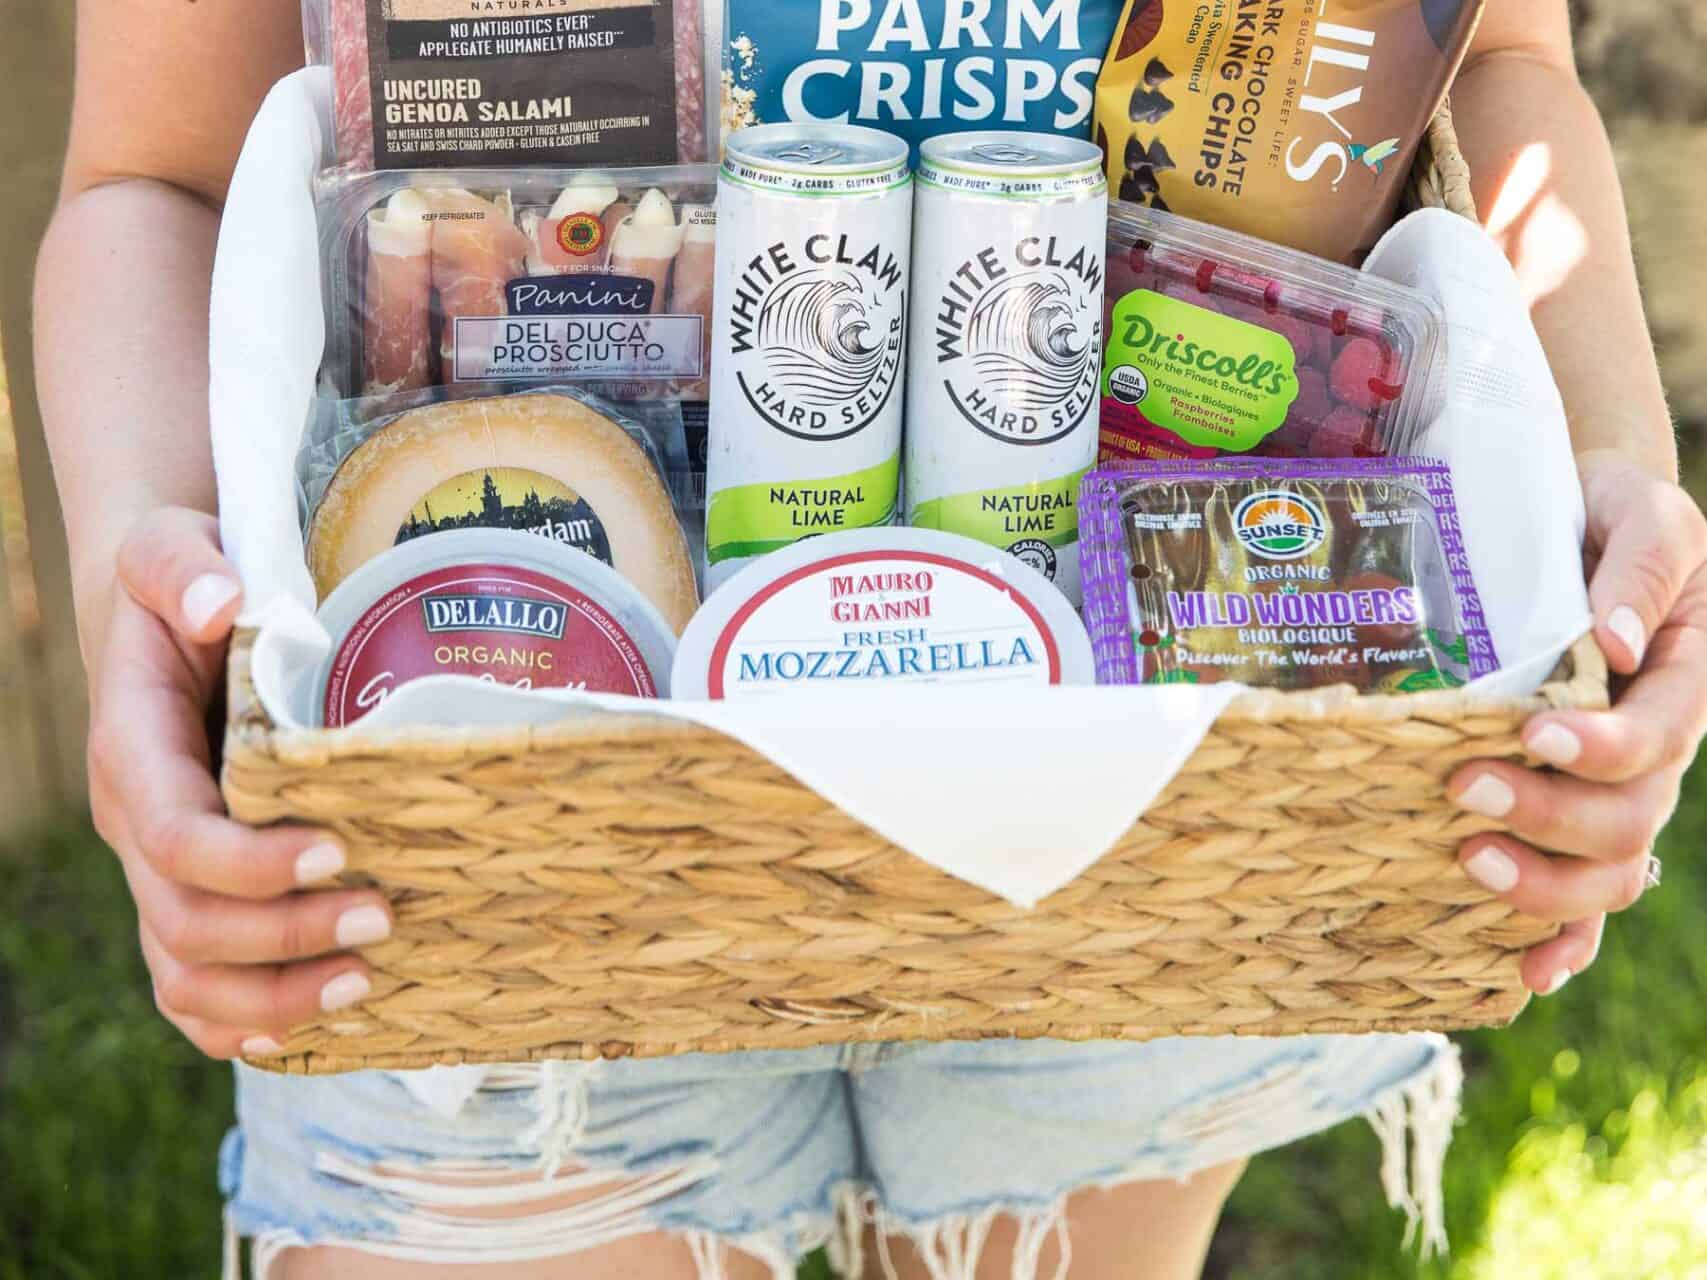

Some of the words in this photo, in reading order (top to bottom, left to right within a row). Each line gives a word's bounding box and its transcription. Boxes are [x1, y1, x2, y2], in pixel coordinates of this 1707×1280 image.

[450, 23, 469, 39] NO
[472, 18, 553, 37] ANTIBIOTICS
[1186, 5, 1210, 45] Cacao
[419, 40, 493, 57] APPLEGATE
[496, 35, 565, 54] HUMANELY
[1187, 21, 1223, 94] Sweetened
[383, 78, 481, 100] UNCURED
[782, 55, 1102, 130] CRISPS
[1279, 77, 1297, 126] SWEET
[385, 102, 469, 124] GENOA
[478, 96, 572, 122] SALAMI
[1222, 45, 1275, 197] CHOCOLATE
[386, 129, 397, 140] NO
[398, 128, 433, 139] NITRATES
[434, 128, 446, 139] OR
[446, 127, 479, 139] NITRITES
[481, 126, 505, 138] ADDED
[506, 125, 533, 137] EXCEPT
[535, 124, 560, 136] THOSE
[560, 120, 599, 134] NATURALLY
[599, 116, 641, 130] OCCURRING
[642, 114, 650, 128] IN
[1193, 92, 1236, 189] CHIPS
[386, 141, 401, 152] SEA
[401, 141, 419, 152] SALT
[420, 140, 435, 152] AND
[435, 140, 458, 151] SWISS
[459, 139, 483, 151] CHARD
[484, 138, 515, 150] POWDER
[520, 136, 548, 148] GLUTEN
[549, 136, 555, 147] &
[555, 134, 581, 147] CASEIN
[582, 131, 601, 144] FREE
[739, 167, 757, 181] MADE
[791, 179, 802, 189] 2g
[805, 179, 834, 189] CARBS
[846, 177, 875, 188] GLUTEN
[876, 175, 892, 185] FREE
[943, 175, 962, 185] MADE
[1000, 183, 1011, 193] 2g
[1014, 183, 1043, 192] CARBS
[512, 281, 646, 312] Panini
[730, 242, 797, 354] WHITE
[805, 233, 902, 292] CLAW
[936, 246, 1007, 363] WHITE
[1015, 236, 1102, 294] CLAW
[506, 322, 558, 344] DEL
[493, 343, 665, 363] PROSCIUTTO
[1122, 314, 1287, 395] Driscoll's
[755, 382, 826, 429] HARD
[841, 316, 900, 424] SELTZER
[965, 388, 1038, 434] HARD
[1051, 320, 1100, 428] SELTZER
[1118, 372, 1140, 386] USDA
[1137, 353, 1164, 370] Only
[1164, 361, 1183, 375] the
[1184, 368, 1218, 388] Finest
[1153, 378, 1193, 399] Organic
[1201, 393, 1259, 421] Biologiques
[1171, 396, 1235, 425] Raspberries
[1173, 409, 1235, 437] Framboises
[769, 487, 865, 506] NATURAL
[981, 491, 1073, 513] NATURAL
[792, 509, 844, 526] LIME
[1004, 513, 1056, 533] LIME
[1238, 523, 1324, 541] SUNSET
[831, 571, 934, 599] MAURO
[1244, 564, 1331, 583] ORGANIC
[430, 599, 558, 632] DELALLO
[831, 595, 931, 623] GIANNI
[1166, 591, 1252, 629] WILD
[1252, 586, 1418, 627] WONDERS
[581, 601, 623, 641] REFRIGERATE
[619, 640, 638, 662] AFTER
[843, 627, 929, 647] FRESH
[1238, 626, 1358, 645] BIOLOGIQUE
[434, 645, 553, 670] ORGANIC
[739, 637, 1035, 682] MOZZARELLA
[1175, 647, 1249, 665] Discover
[1253, 649, 1288, 665] The
[1292, 647, 1359, 665] World's
[1363, 647, 1427, 665] Flavors
